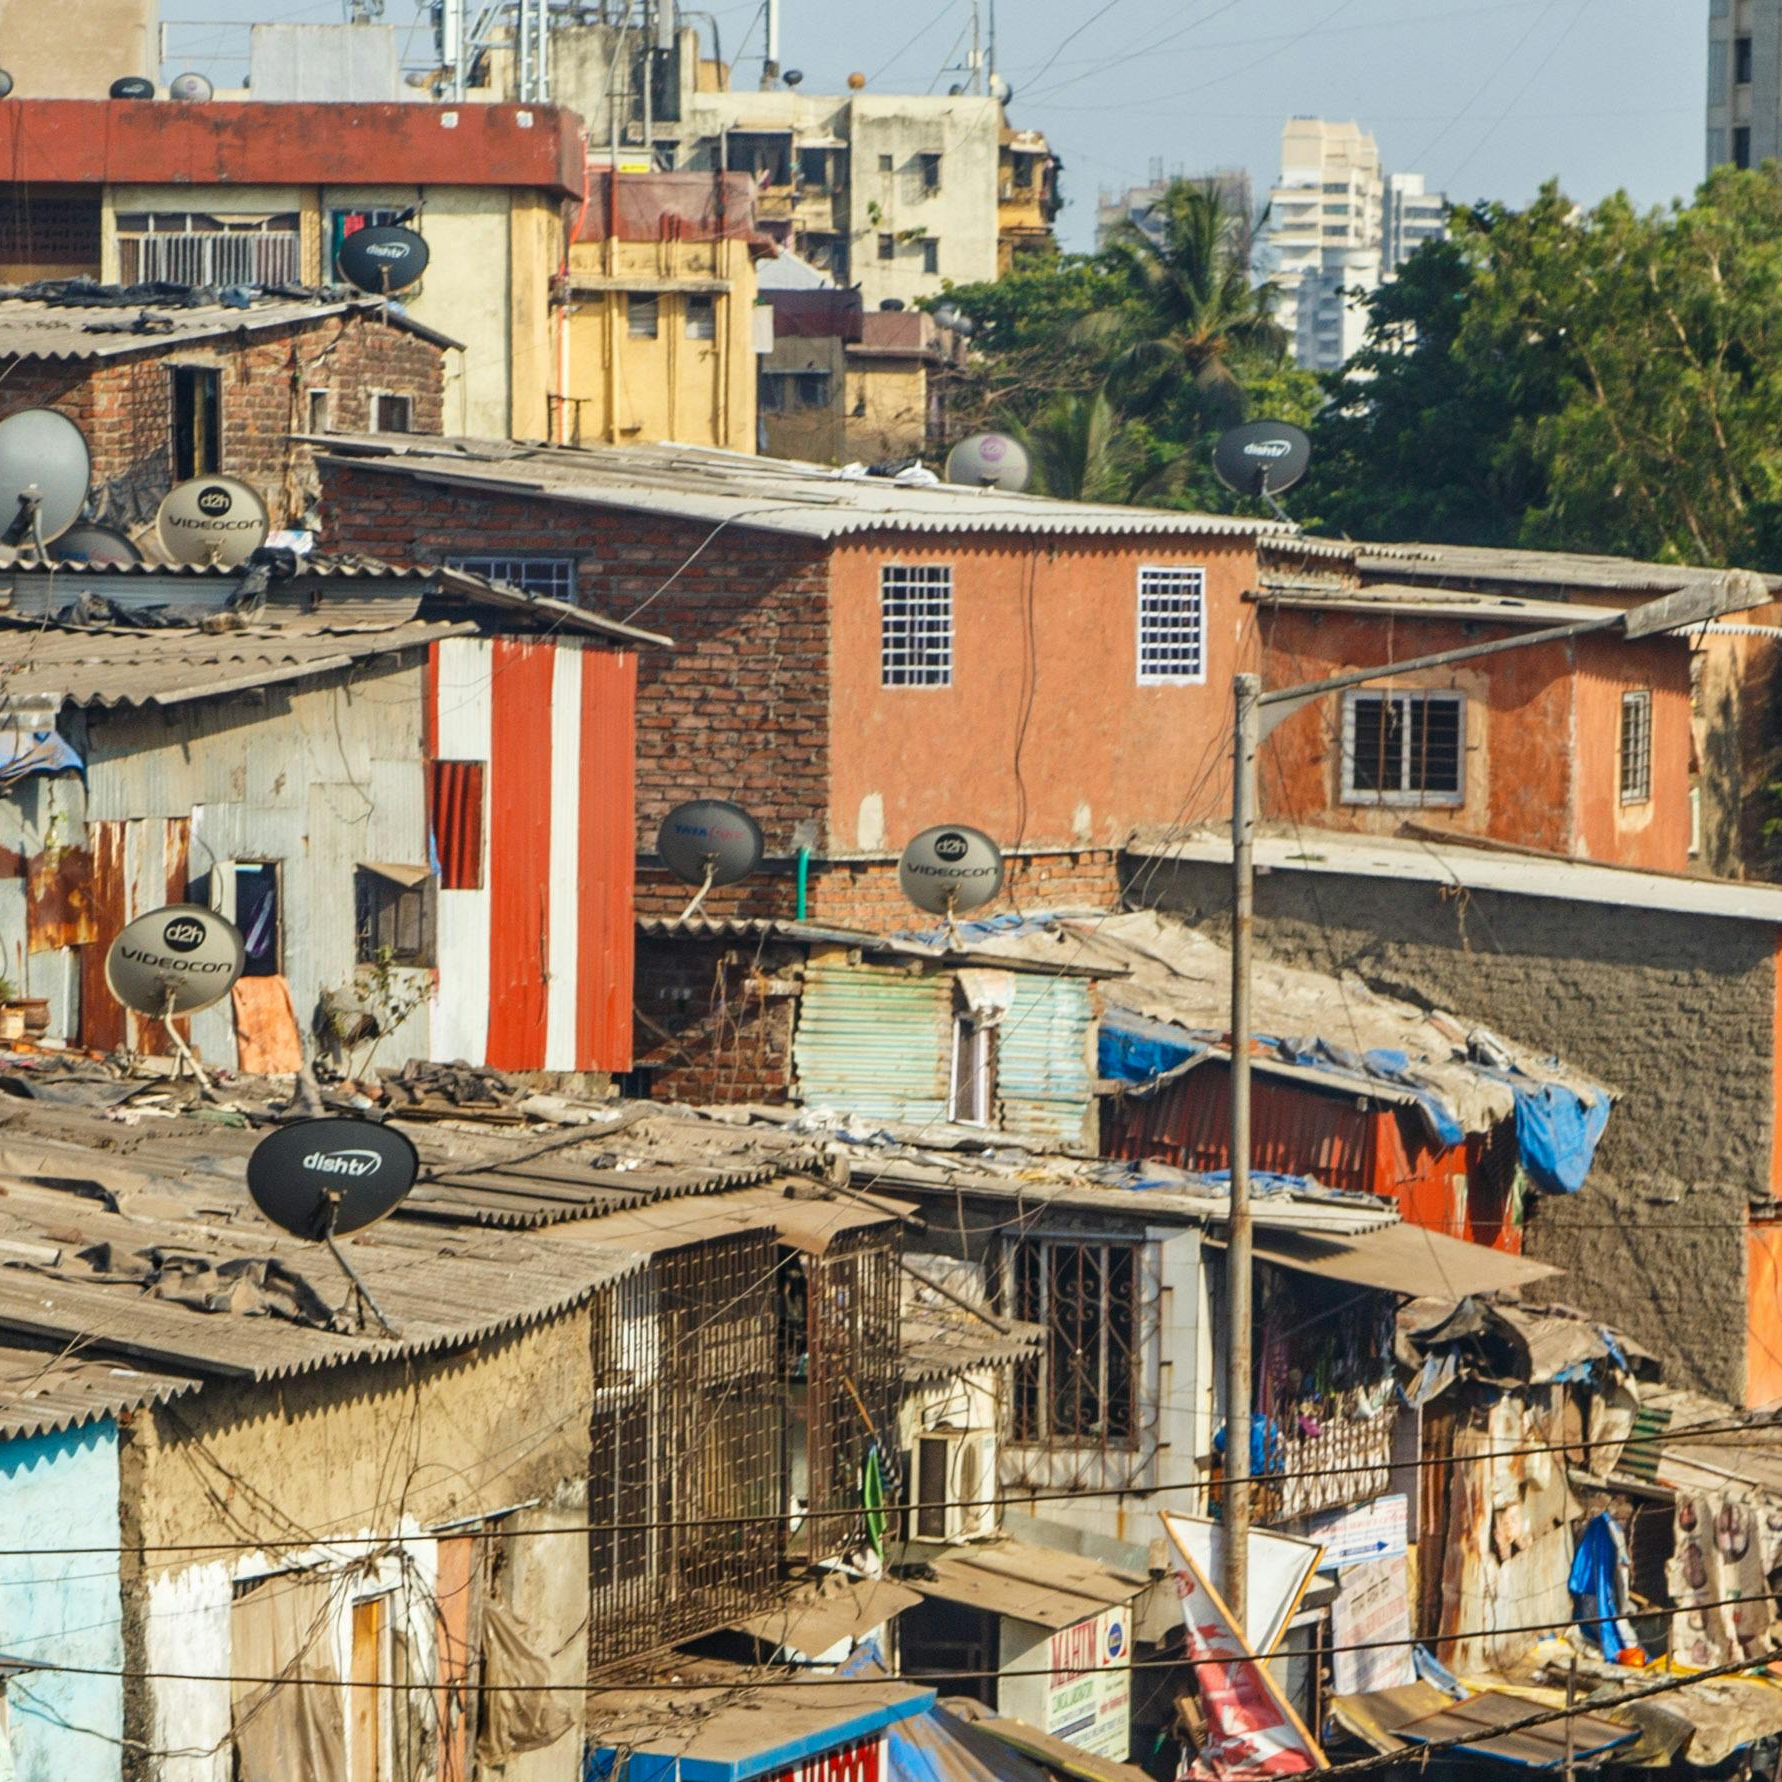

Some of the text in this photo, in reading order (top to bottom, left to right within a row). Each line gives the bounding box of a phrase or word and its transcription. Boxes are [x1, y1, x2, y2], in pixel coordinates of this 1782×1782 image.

[201, 494, 230, 508] d2h
[169, 514, 263, 531] VIDEOCON
[936, 840, 967, 854] d2h
[907, 863, 998, 877] VIDEOCON
[166, 924, 203, 942] d2h
[121, 948, 232, 972] VIDEOCON
[303, 1150, 381, 1176] dishtv
